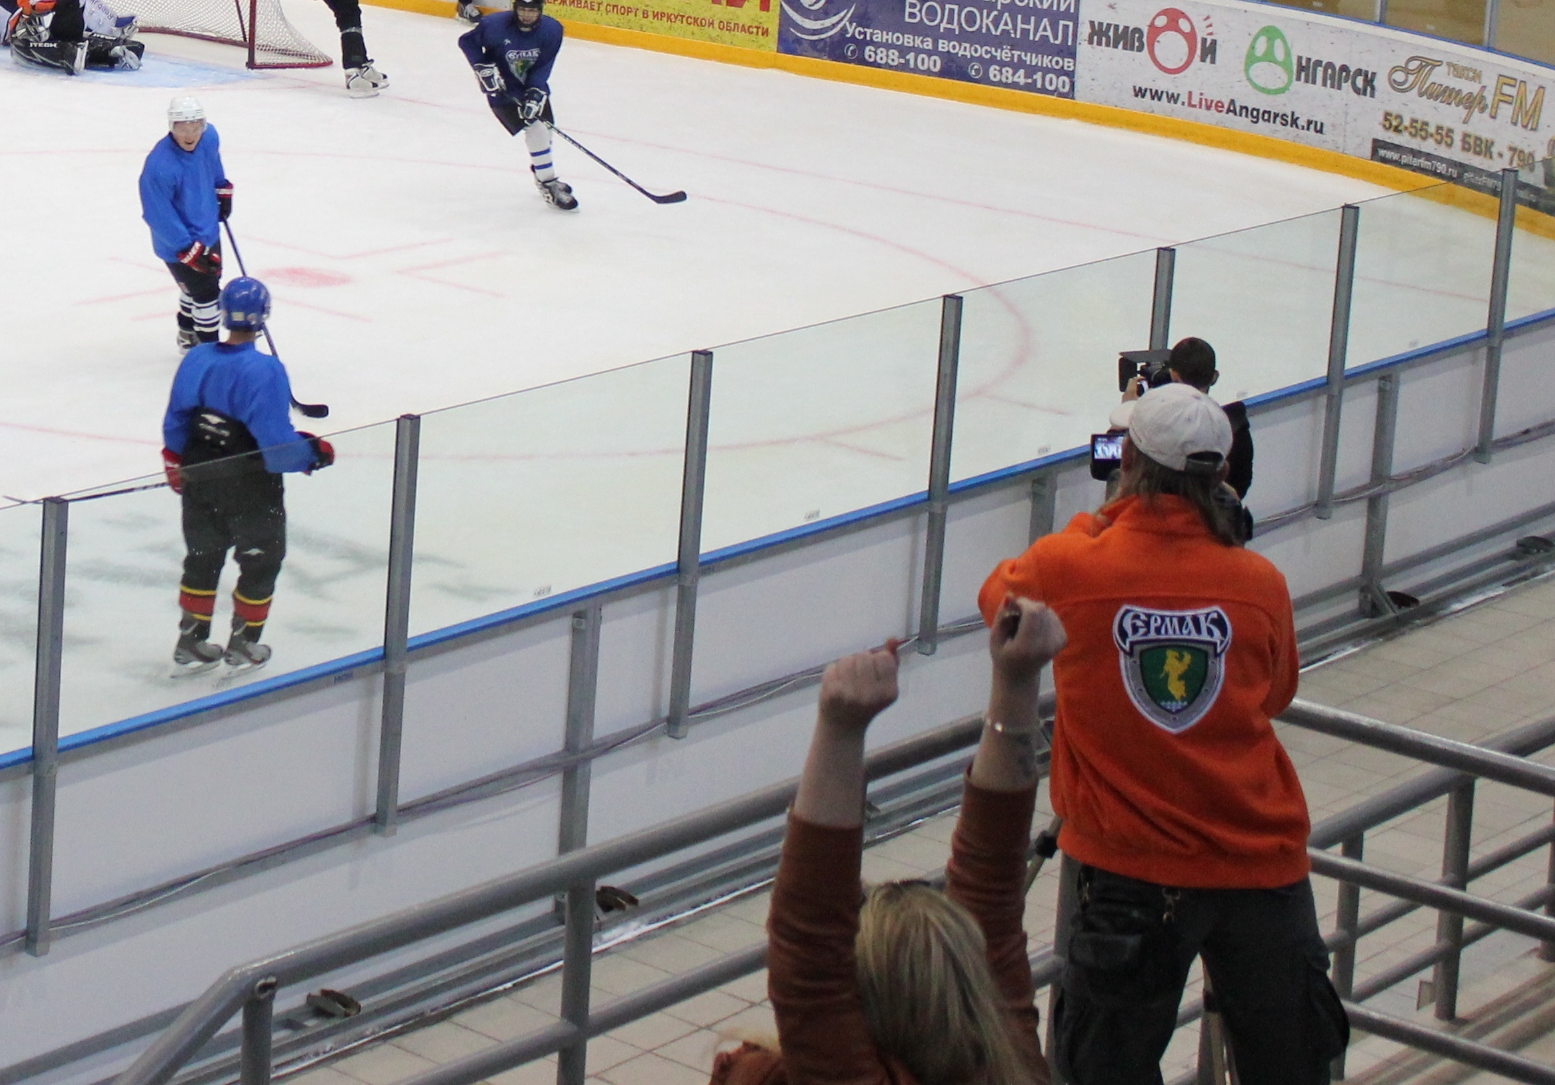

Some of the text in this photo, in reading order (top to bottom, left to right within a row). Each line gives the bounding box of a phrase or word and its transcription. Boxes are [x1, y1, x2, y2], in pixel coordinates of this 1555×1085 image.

[605, 1, 638, 18] СПОРТ
[717, 20, 770, 38] ОБЛАСТИ
[844, 21, 1075, 72] Установка водосчётчиков
[864, 45, 1071, 94] 688-100 684-100
[1132, 83, 1326, 136] www.LiveAngarsk.ru
[1489, 74, 1547, 133] FM
[1381, 109, 1456, 150] 52-55-55
